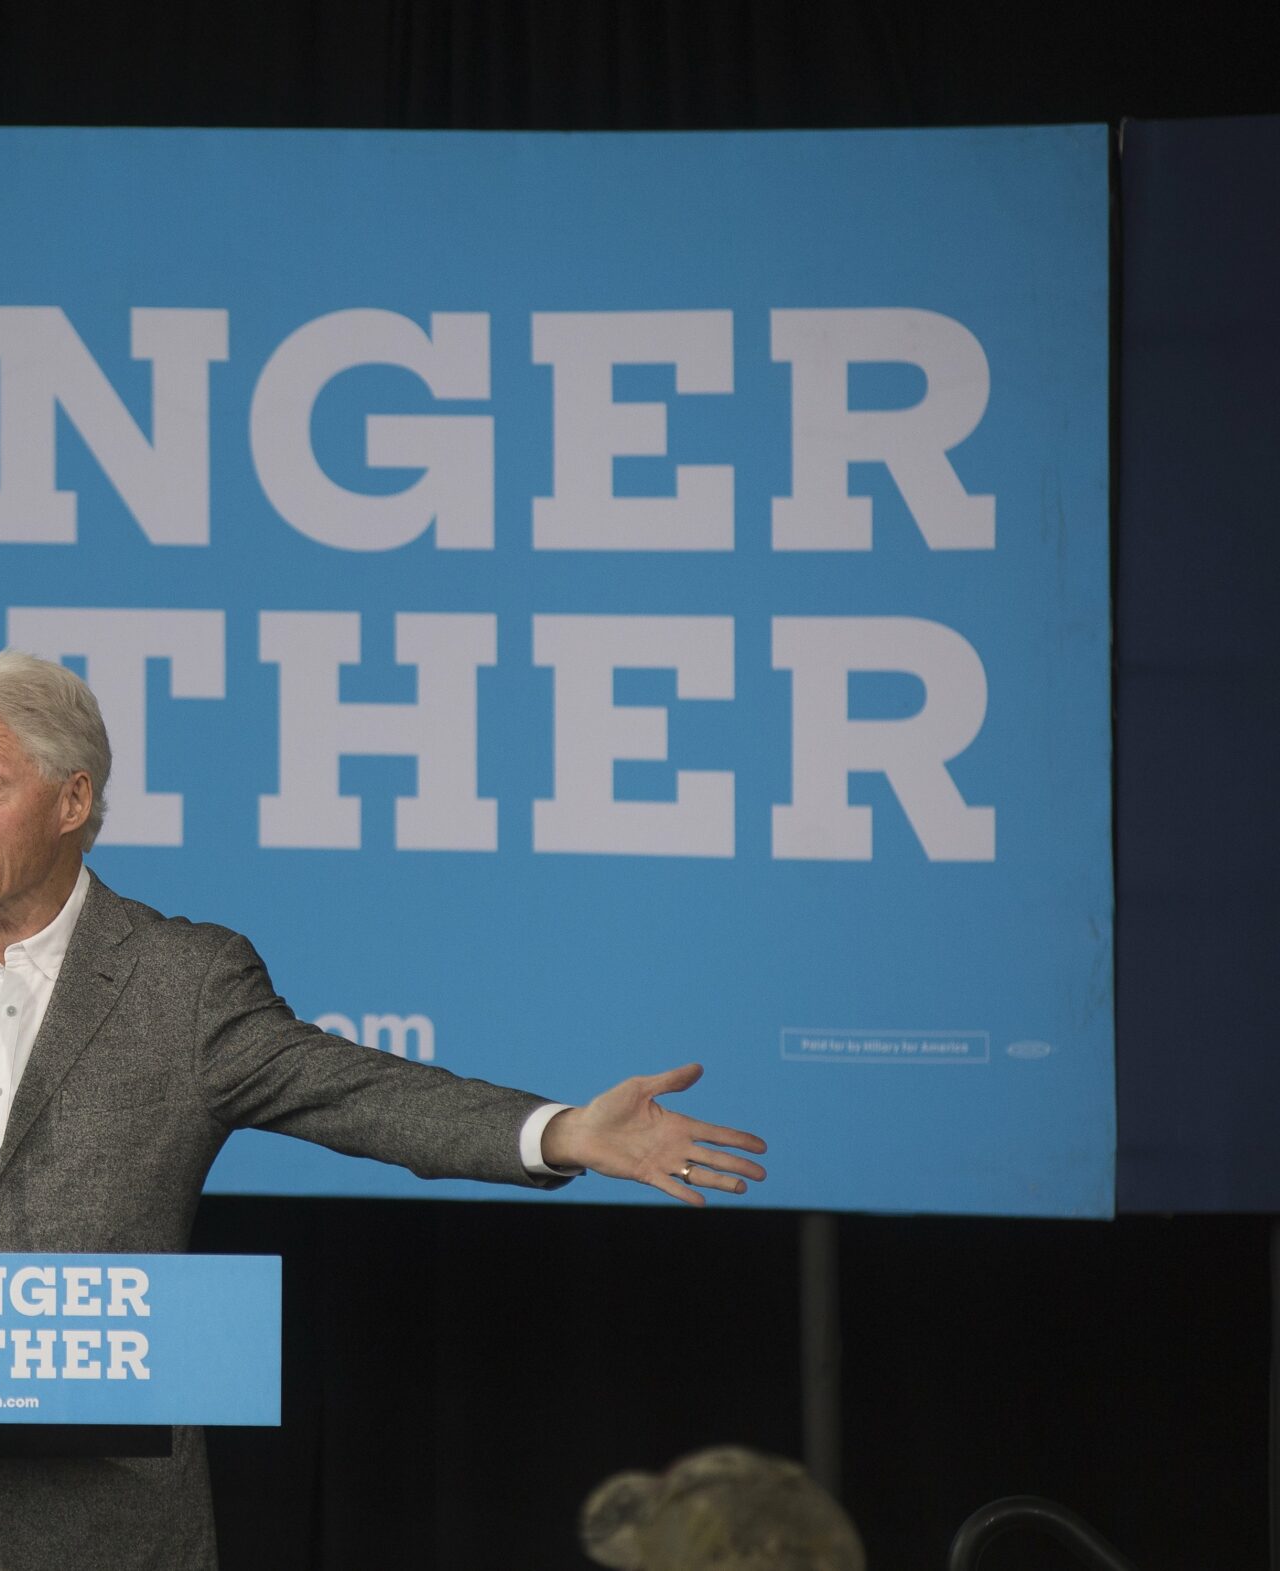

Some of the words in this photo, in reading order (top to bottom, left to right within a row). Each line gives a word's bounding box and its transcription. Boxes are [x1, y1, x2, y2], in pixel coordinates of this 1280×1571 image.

[829, 1039, 846, 1051] for
[848, 1039, 861, 1053] by
[863, 1039, 900, 1054] Hillary
[902, 1040, 919, 1052] for
[921, 1041, 969, 1053] America
